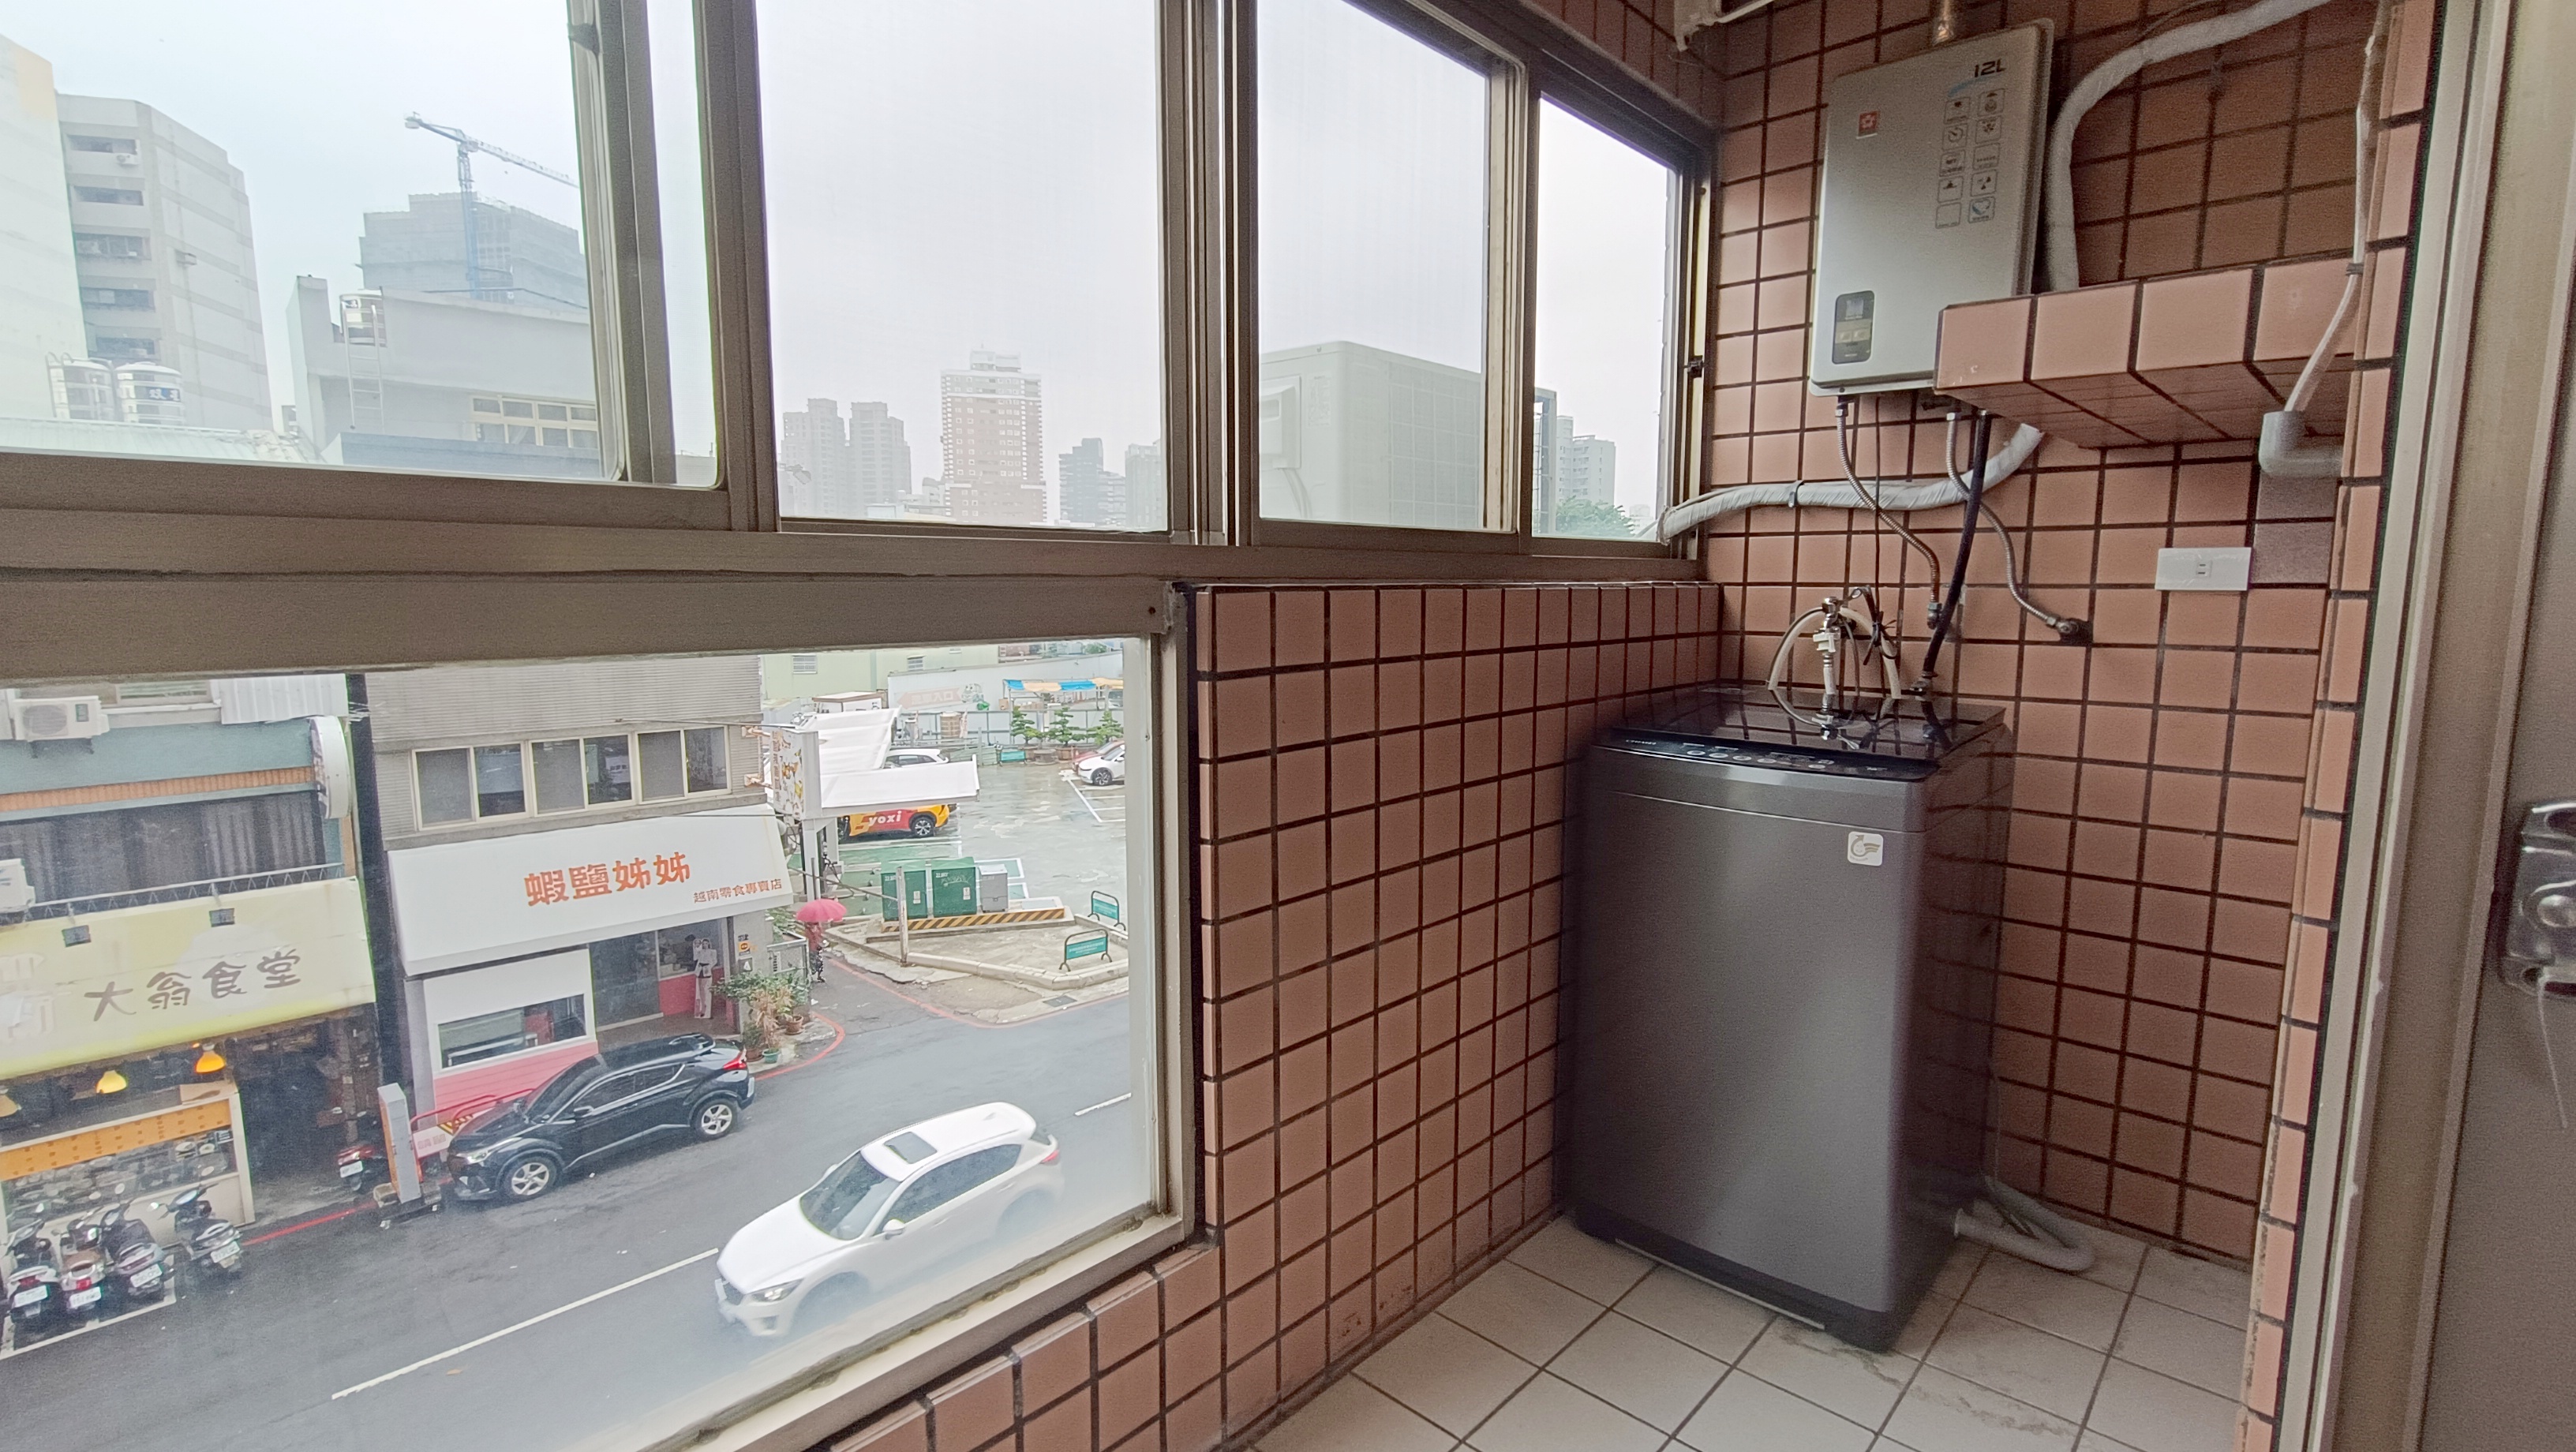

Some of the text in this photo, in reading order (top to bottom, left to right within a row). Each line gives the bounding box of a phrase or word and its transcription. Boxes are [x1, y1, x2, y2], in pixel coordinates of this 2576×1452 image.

[1974, 58, 2007, 78] 12L
[868, 810, 902, 827] yoxi
[523, 851, 691, 907] 蝦鹽姊姊
[693, 878, 783, 904] 越南零食專賣店
[84, 949, 301, 1022] 大翁食堂
